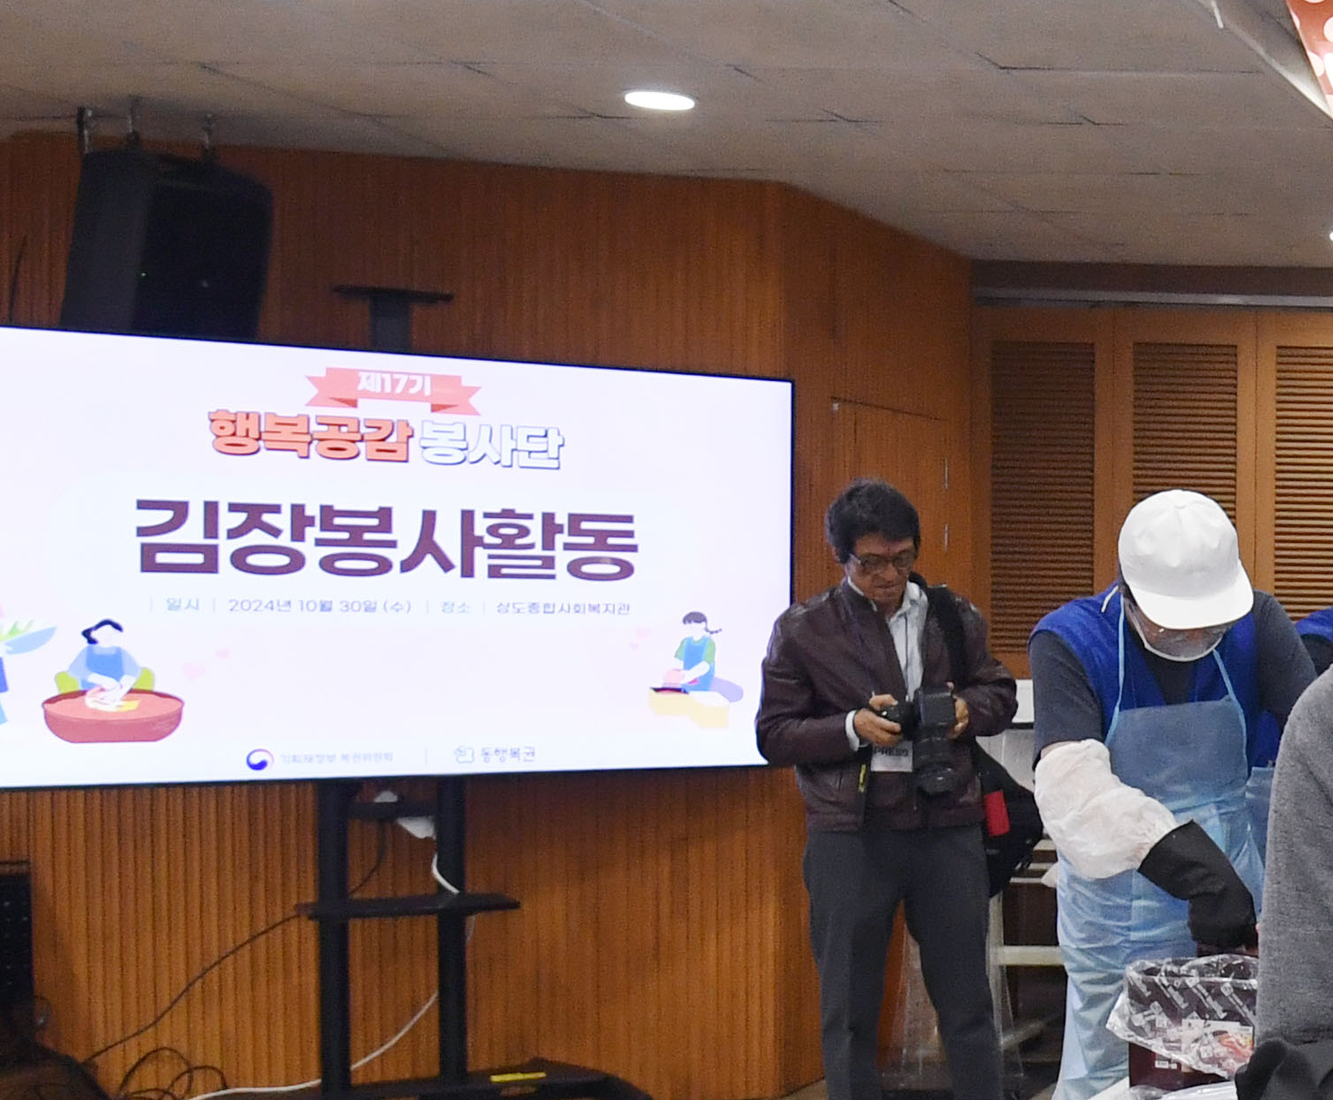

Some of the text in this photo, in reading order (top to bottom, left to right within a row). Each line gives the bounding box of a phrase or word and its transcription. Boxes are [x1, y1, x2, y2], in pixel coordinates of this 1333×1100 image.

[358, 371, 432, 397] 제17기
[208, 409, 564, 470] 행복공감 봉사단
[136, 499, 639, 582] 김장봉사활동
[166, 598, 630, 615] 일시 2024년 10월 30일 (수) 장소 상도종합사회복지관
[480, 746, 536, 763] 동행복권
